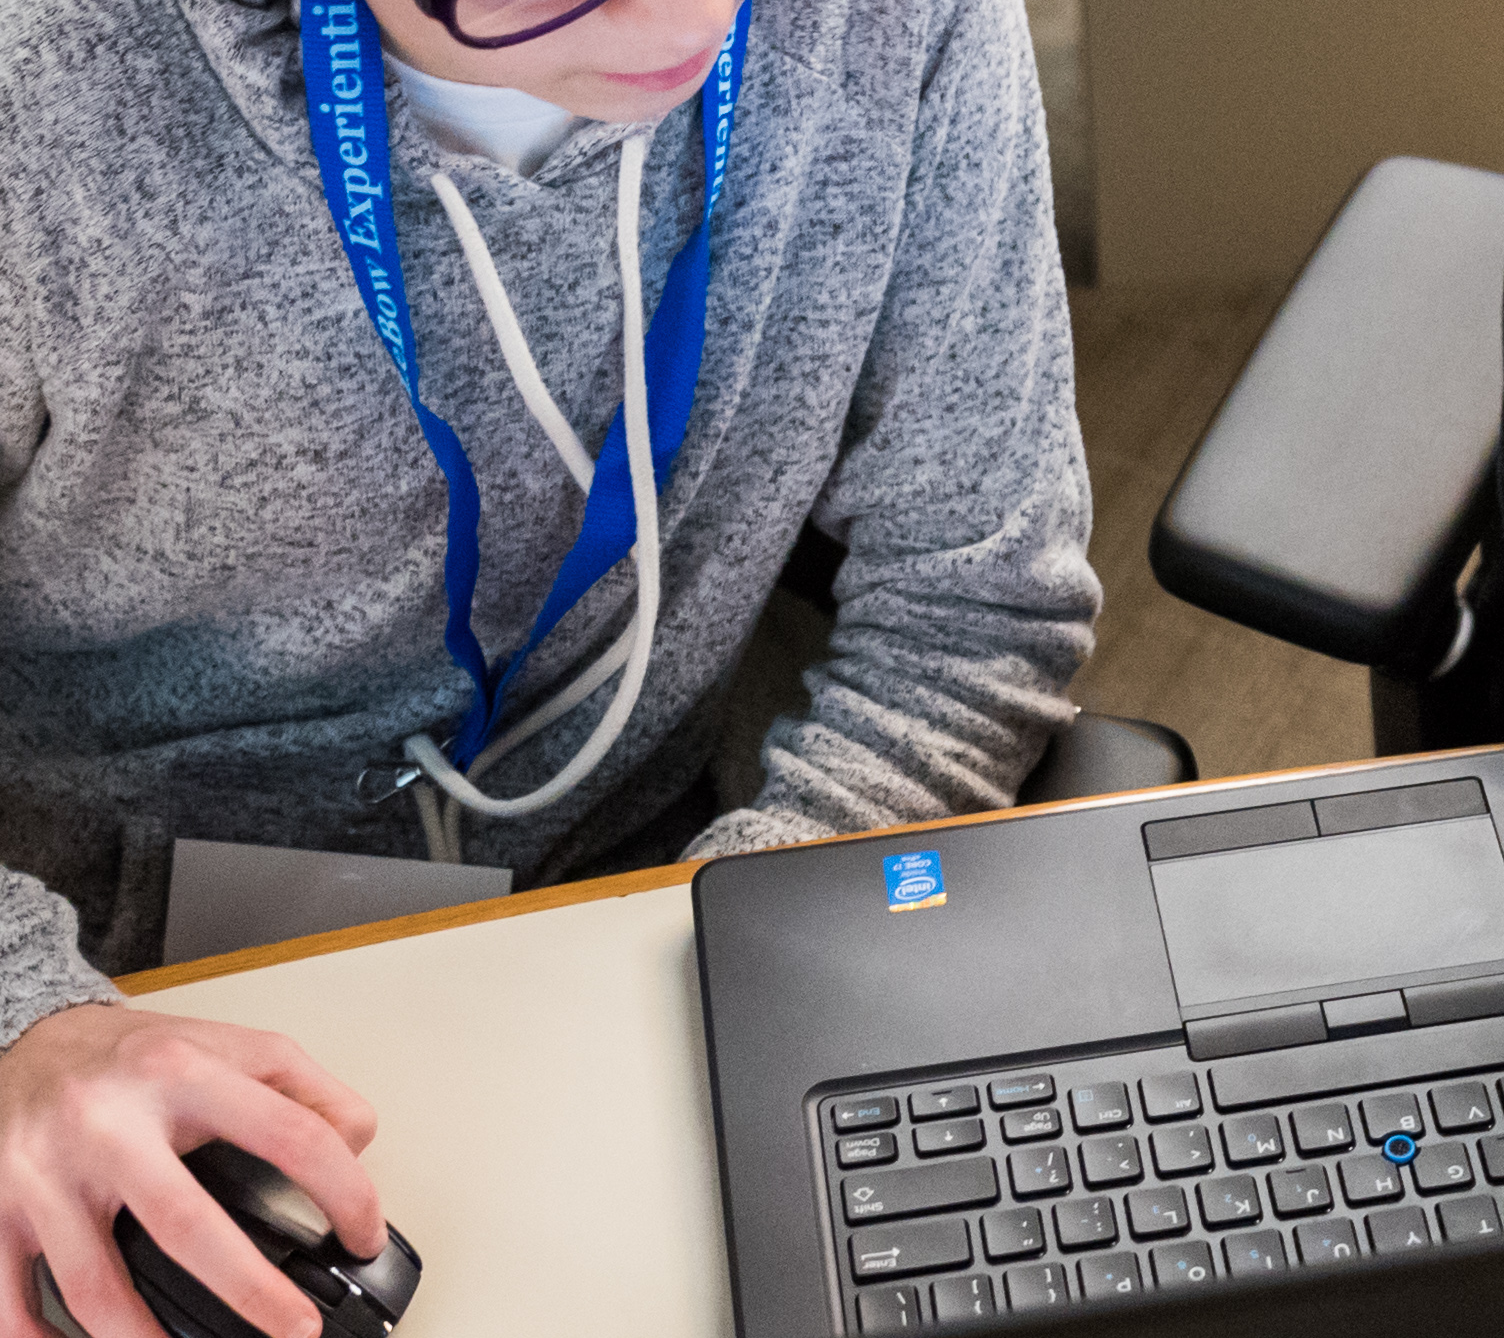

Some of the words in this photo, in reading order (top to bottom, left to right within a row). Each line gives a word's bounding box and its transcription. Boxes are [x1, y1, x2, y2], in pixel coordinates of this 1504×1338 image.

[904, 859, 932, 869] CORE
[902, 883, 931, 895] intel
[1175, 1099, 1192, 1110] Alt
[1099, 1108, 1122, 1121] Ctrl
[853, 1200, 884, 1215] Shift
[863, 1257, 898, 1272] Enter
